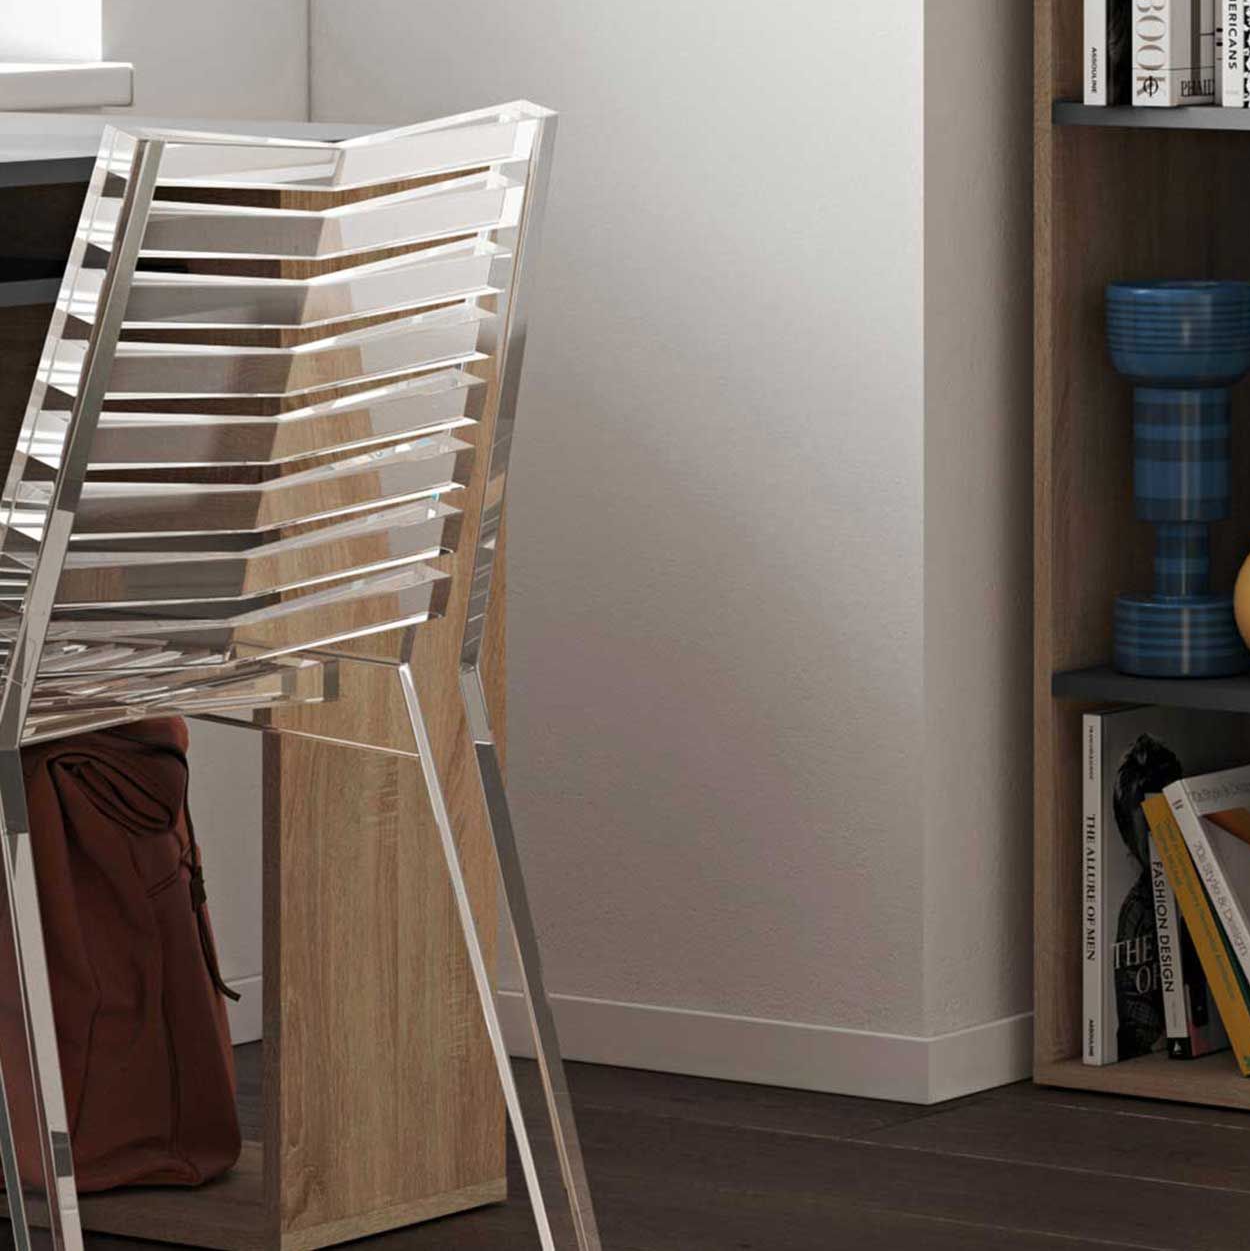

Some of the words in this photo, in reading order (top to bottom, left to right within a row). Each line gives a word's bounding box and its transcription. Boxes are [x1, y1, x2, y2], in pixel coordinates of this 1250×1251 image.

[1181, 78, 1215, 97] PHAID
[1086, 813, 1096, 843] THE
[1086, 848, 1096, 902] ALLURE
[1152, 861, 1169, 927] FASHION
[1086, 906, 1096, 926] OF
[1086, 928, 1096, 961] MEN
[1113, 935, 1153, 969] THE
[1160, 935, 1175, 992] DESIGN
